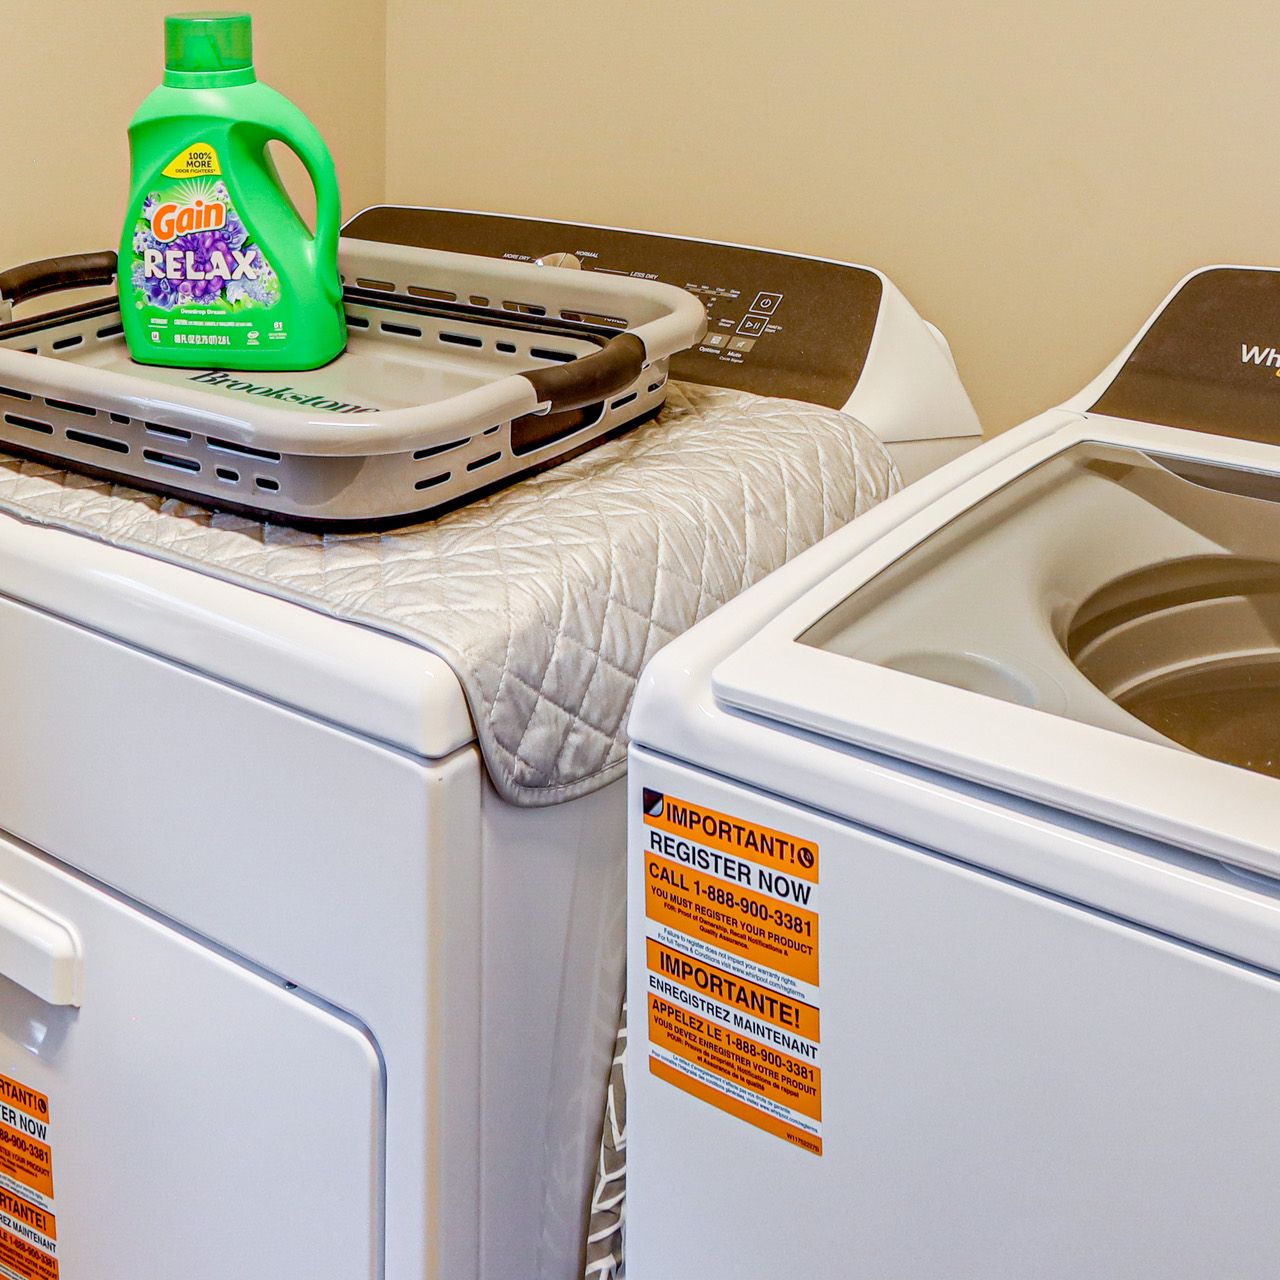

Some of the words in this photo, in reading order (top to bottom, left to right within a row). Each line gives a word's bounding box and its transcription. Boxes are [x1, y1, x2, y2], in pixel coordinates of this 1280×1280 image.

[186, 160, 212, 168] MORE
[188, 152, 212, 160] 100%
[152, 199, 225, 241] Gain
[144, 249, 258, 280] RELAX
[575, 250, 599, 259] NORMAL
[666, 802, 794, 864] IMPORTANT!
[650, 830, 750, 885] REGISTER
[758, 868, 811, 906] NOW
[649, 861, 688, 891] CALL
[694, 879, 810, 937] 1-888-900-3381
[651, 885, 668, 900] YOU
[670, 893, 692, 910] MUST
[695, 903, 737, 928] REGISTER
[740, 920, 765, 938] YOUR
[767, 930, 812, 956] PRODUCT
[699, 925, 717, 938] Quality
[660, 951, 799, 1029] IMPORTANTE!
[649, 975, 730, 1023] ENREGISTREZ
[733, 1012, 817, 1061] MAINTENANT
[652, 998, 703, 1033] APPELEZ
[707, 1024, 721, 1041] LE
[726, 1032, 813, 1083] 1-888-900-3381
[654, 1016, 672, 1031] VOUS
[674, 1025, 696, 1042] DEVEZ
[699, 1036, 750, 1068] ENREGISTRER
[753, 1061, 778, 1081] VOTRE
[781, 1073, 816, 1097] PRODUIT
[19, 1114, 46, 1141] NOW
[0, 1229, 7, 1242] LE
[12, 1221, 56, 1253] MAINTENANT
